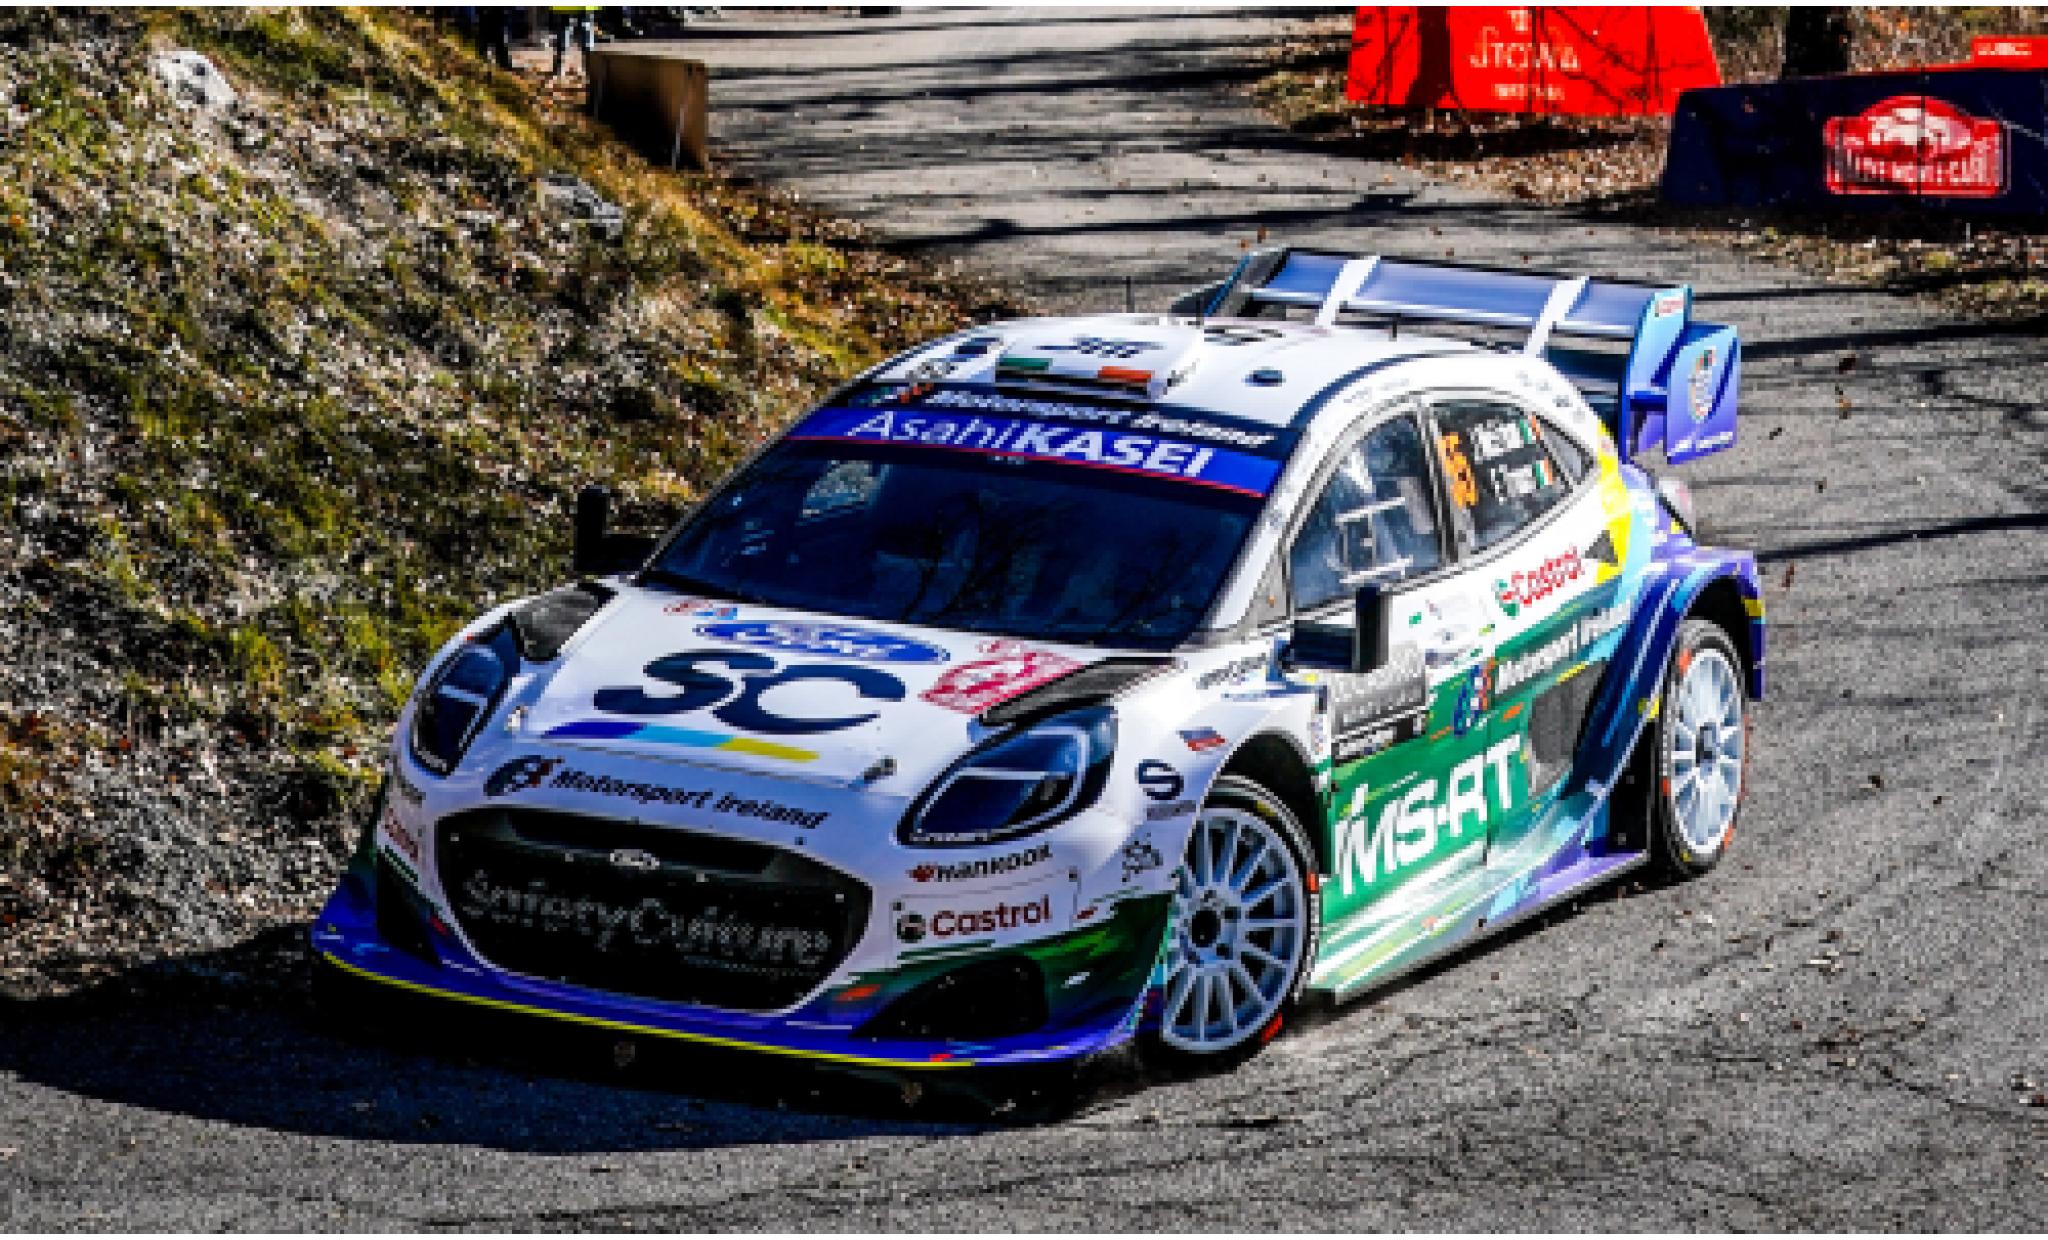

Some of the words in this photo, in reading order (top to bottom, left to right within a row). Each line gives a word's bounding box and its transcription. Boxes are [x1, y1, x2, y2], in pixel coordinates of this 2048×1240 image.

[593, 648, 906, 735] SC
[551, 766, 714, 808] Motorsport
[713, 791, 831, 830] Ireland
[930, 894, 1051, 937] Castrol
